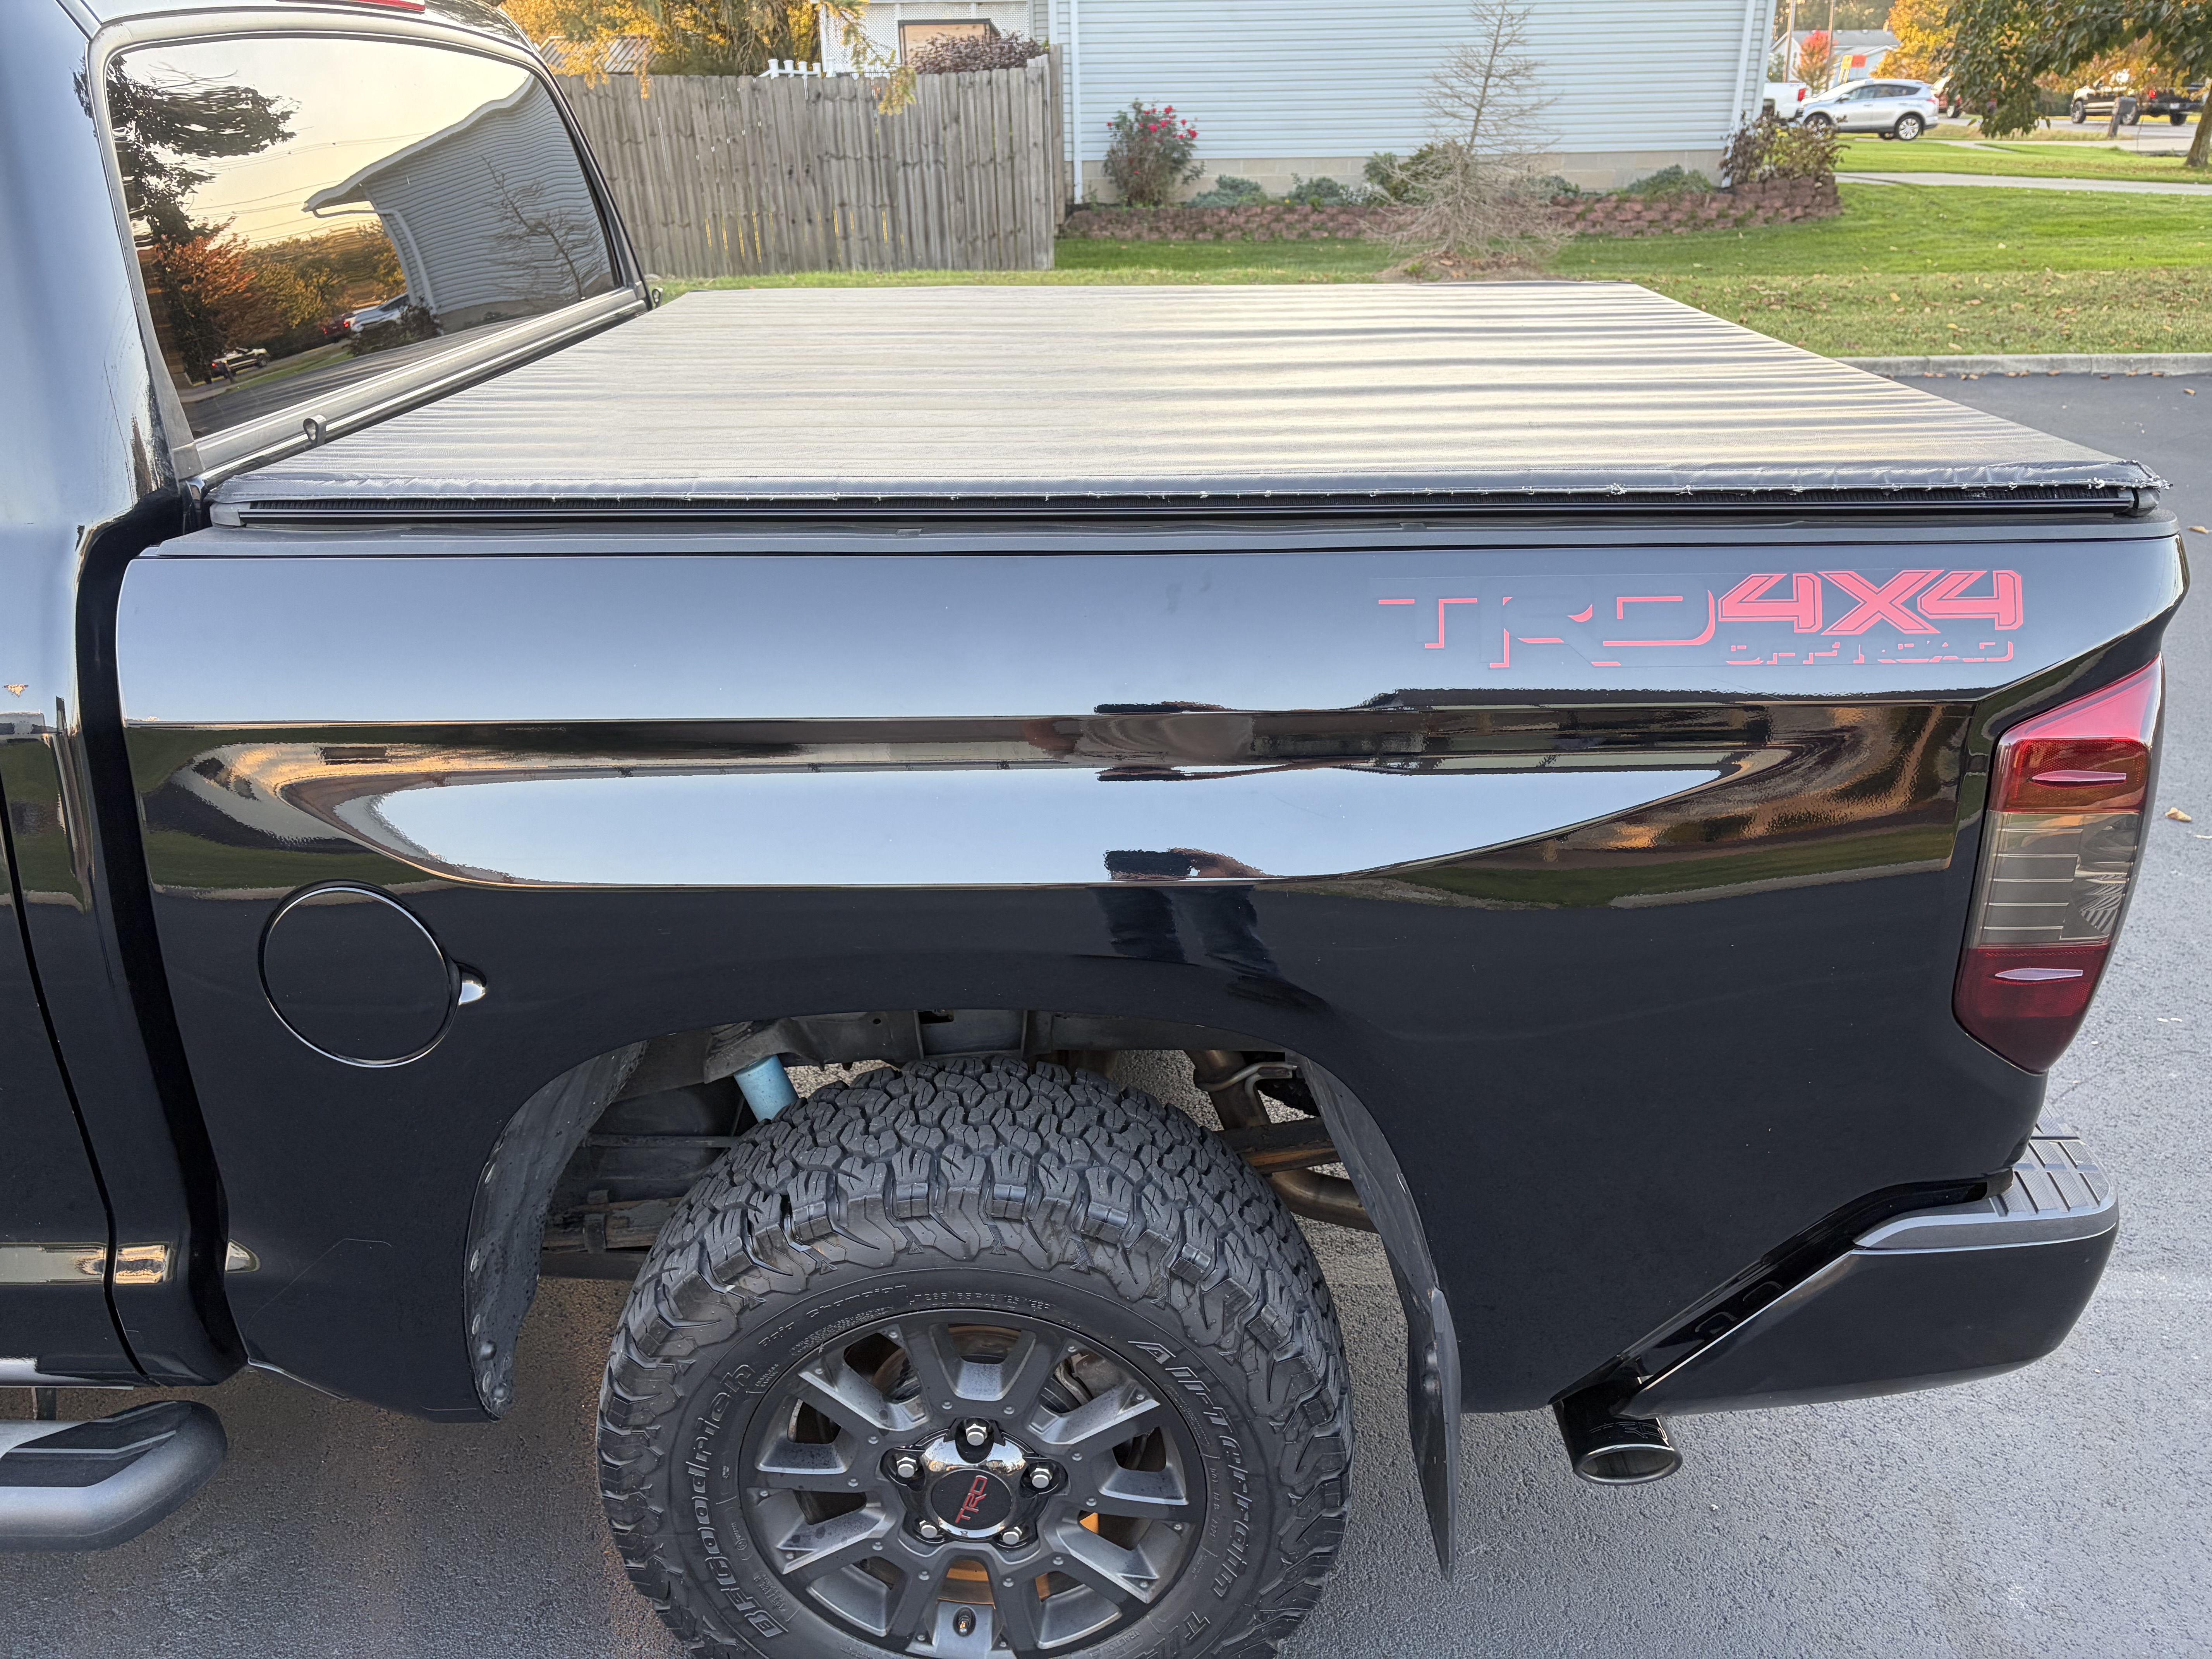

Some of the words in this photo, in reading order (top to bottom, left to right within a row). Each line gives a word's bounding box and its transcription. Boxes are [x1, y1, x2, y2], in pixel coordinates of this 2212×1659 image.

[1378, 590, 1716, 668] TRD
[1718, 569, 2023, 635] 4X4
[685, 1364, 789, 1638] BFGoodrich
[955, 1475, 988, 1524] TRD
